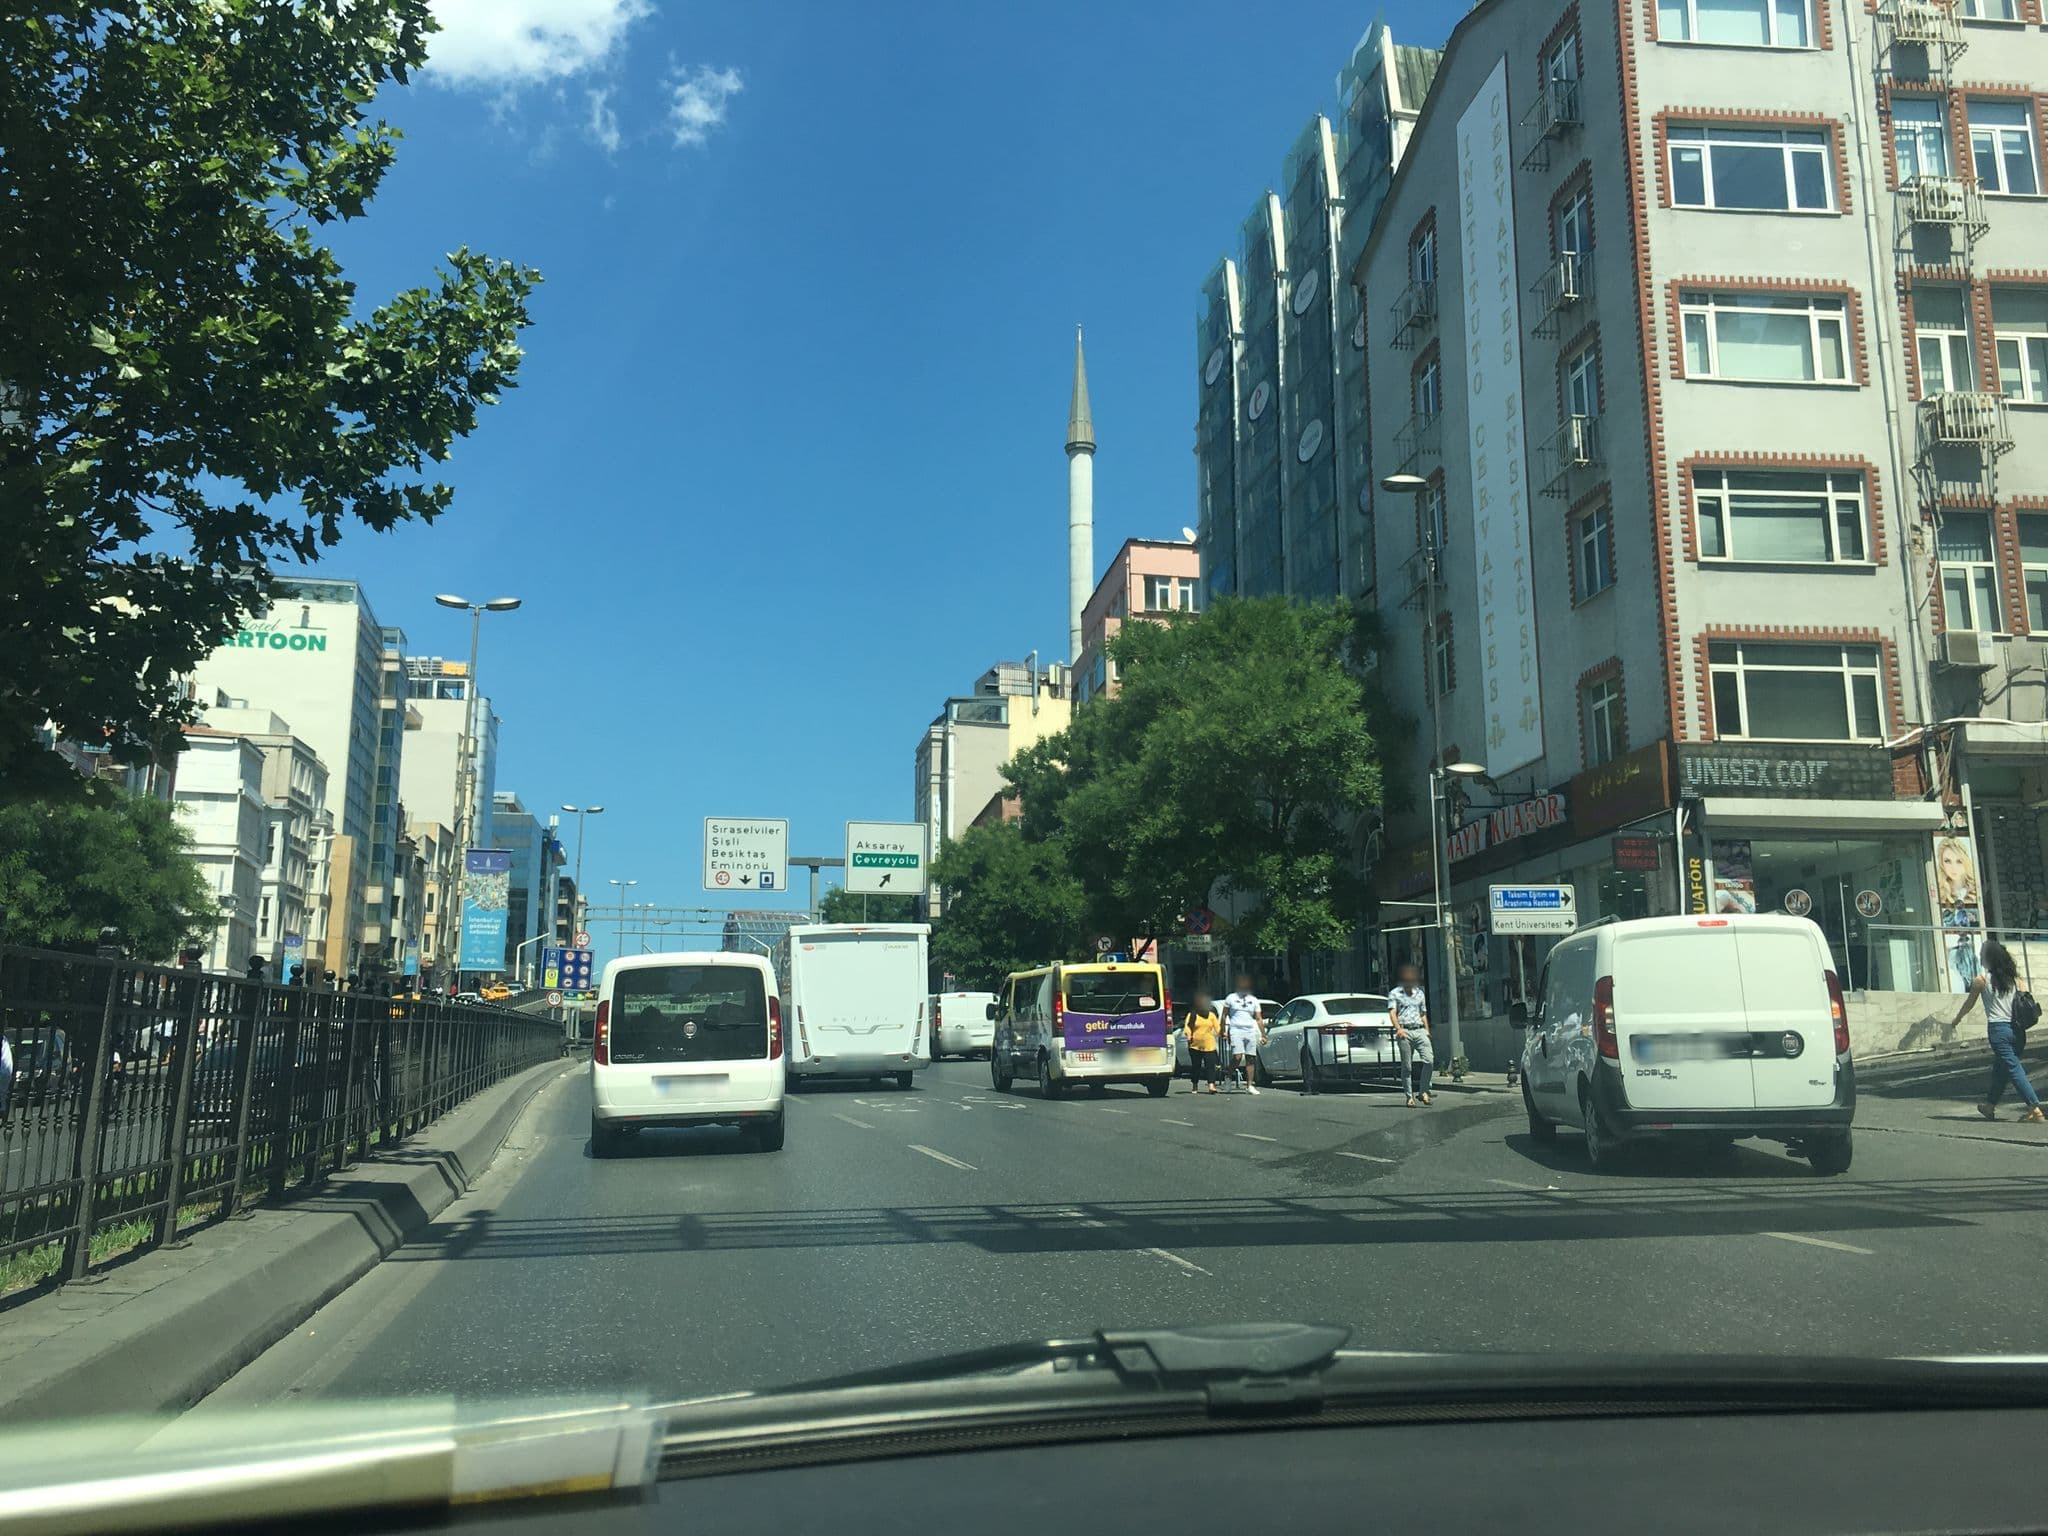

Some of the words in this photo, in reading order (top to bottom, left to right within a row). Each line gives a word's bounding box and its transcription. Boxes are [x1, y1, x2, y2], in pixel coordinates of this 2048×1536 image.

[1463, 134, 1483, 395] INSTITUTO
[221, 631, 327, 651] ARTOON
[1686, 757, 1772, 787] UNISEX
[856, 841, 905, 853] Aksaray
[855, 854, 917, 867] Çevreyolu
[1687, 858, 1707, 914] UAFÖR
[1495, 920, 1513, 929] Kent
[1515, 918, 1562, 929] Üniversitesi
[1085, 1020, 1110, 1033] getir
